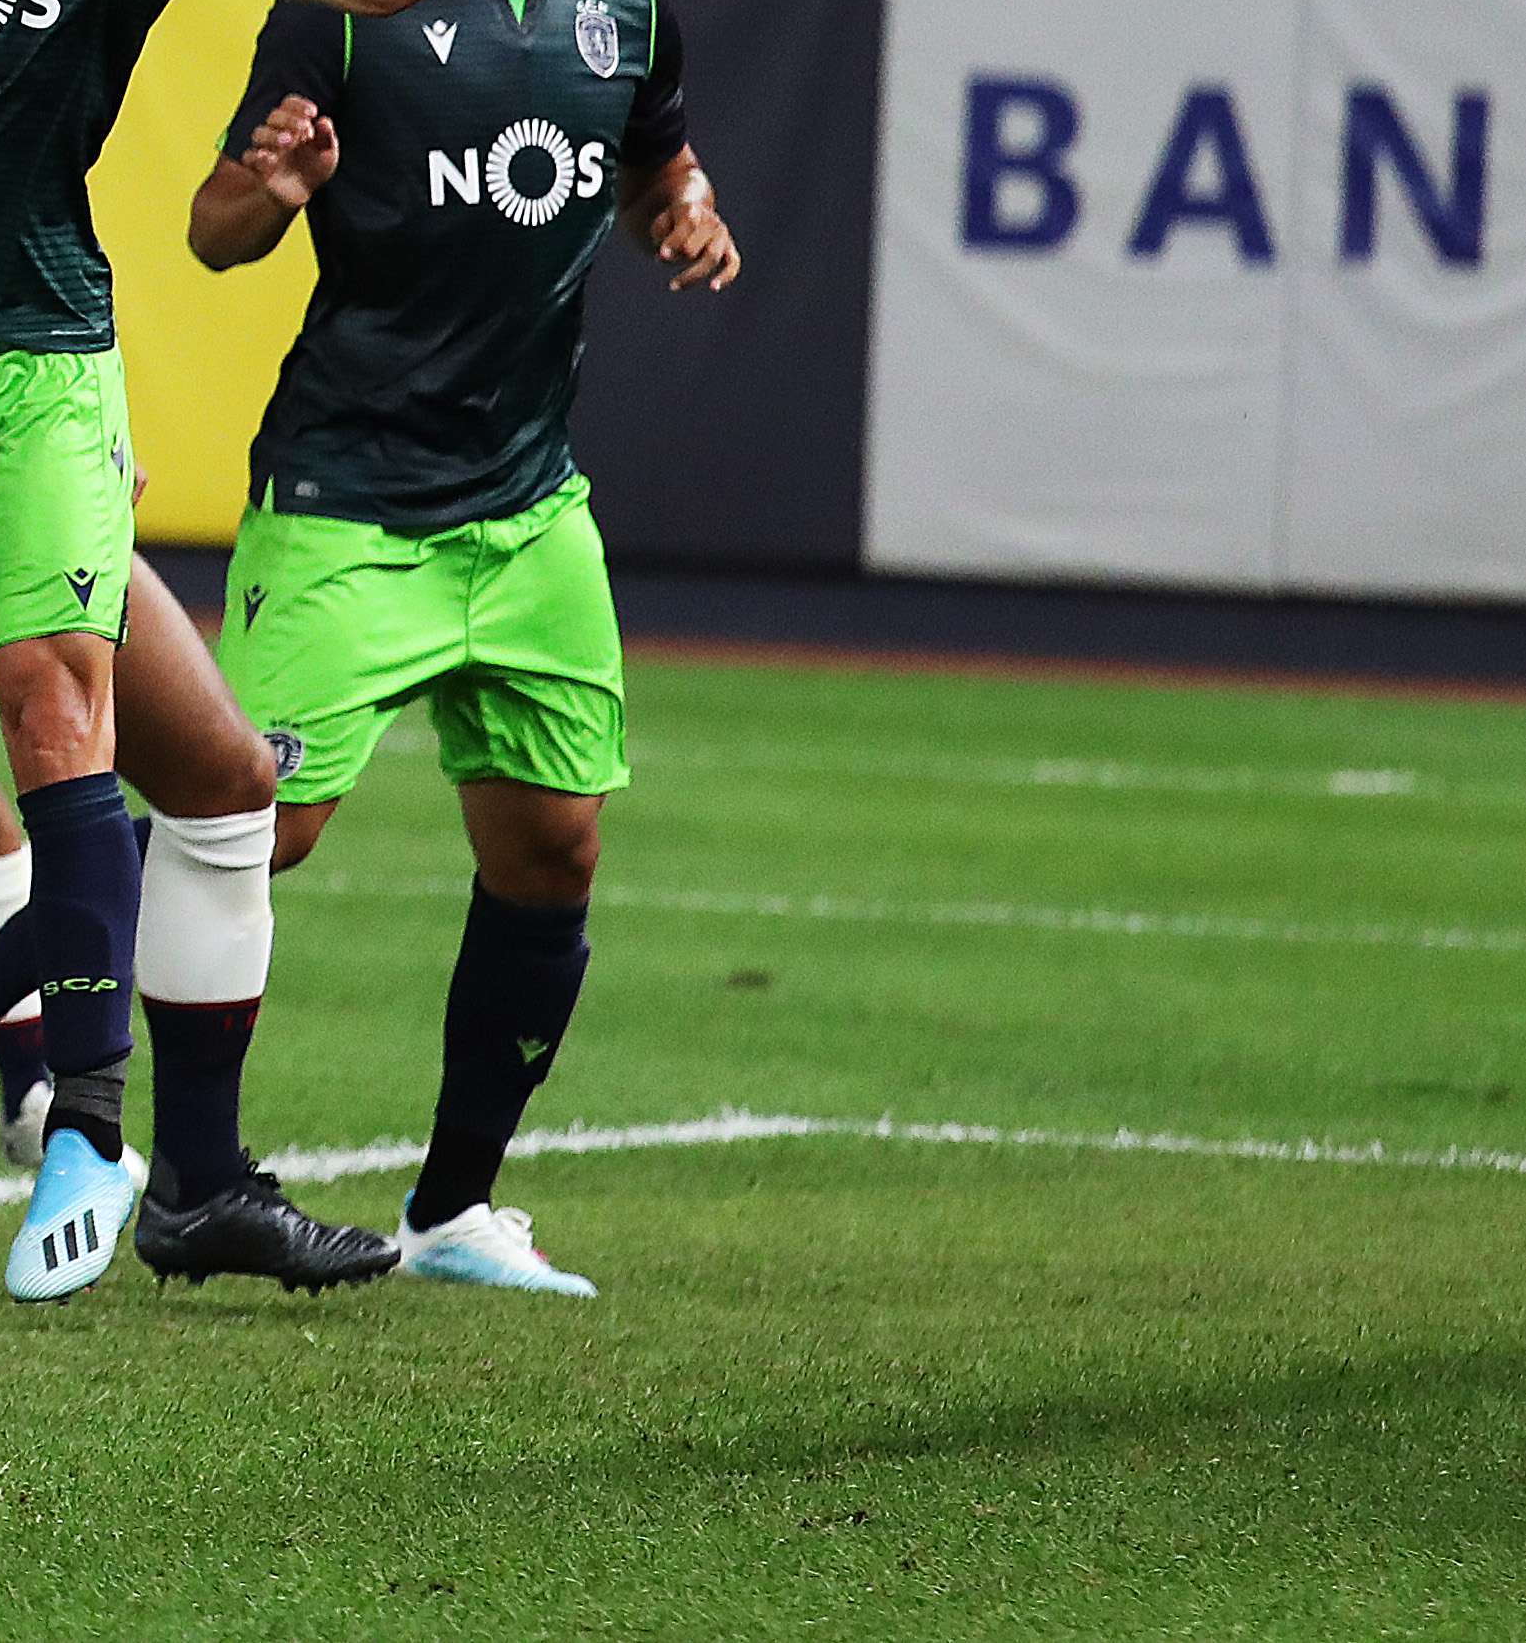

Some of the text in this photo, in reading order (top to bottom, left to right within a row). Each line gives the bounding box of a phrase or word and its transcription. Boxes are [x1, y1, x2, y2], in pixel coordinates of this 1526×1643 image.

[428, 117, 605, 227] NOS
[957, 68, 1494, 275] BAN
[43, 977, 118, 997] SCP
